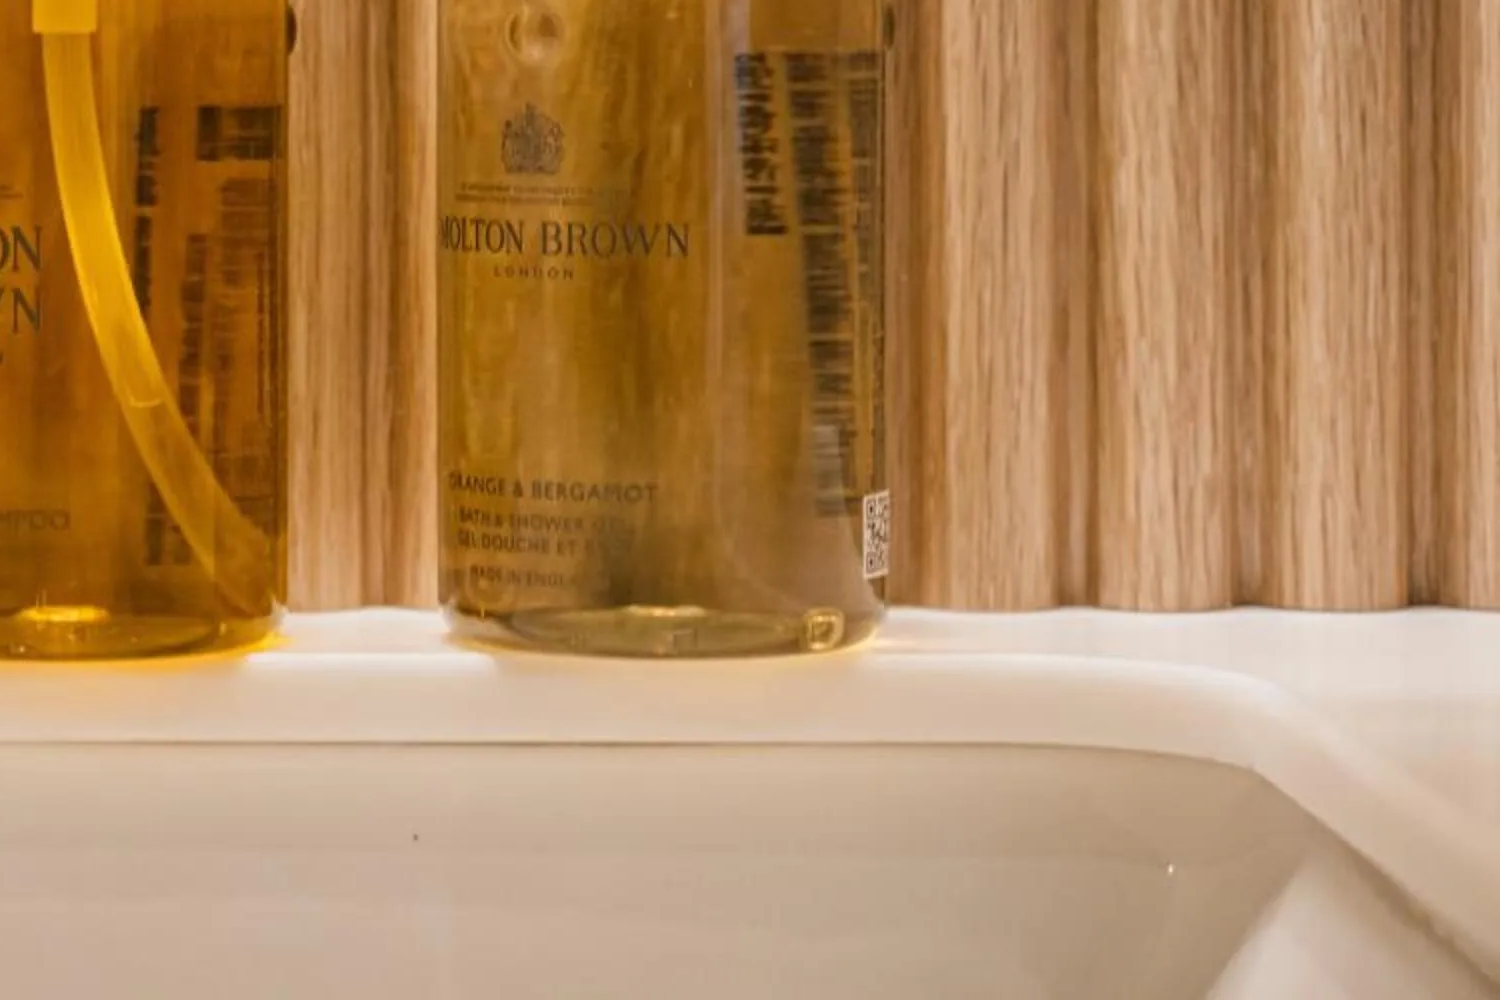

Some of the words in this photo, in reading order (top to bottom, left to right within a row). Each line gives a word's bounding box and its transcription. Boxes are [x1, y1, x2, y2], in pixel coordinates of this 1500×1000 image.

[540, 219, 690, 259] BROWN
[493, 266, 574, 281] LONDON
[532, 480, 659, 505] BERGAMOT
[510, 511, 584, 533] SHOWER
[481, 532, 550, 554] DOUCHE
